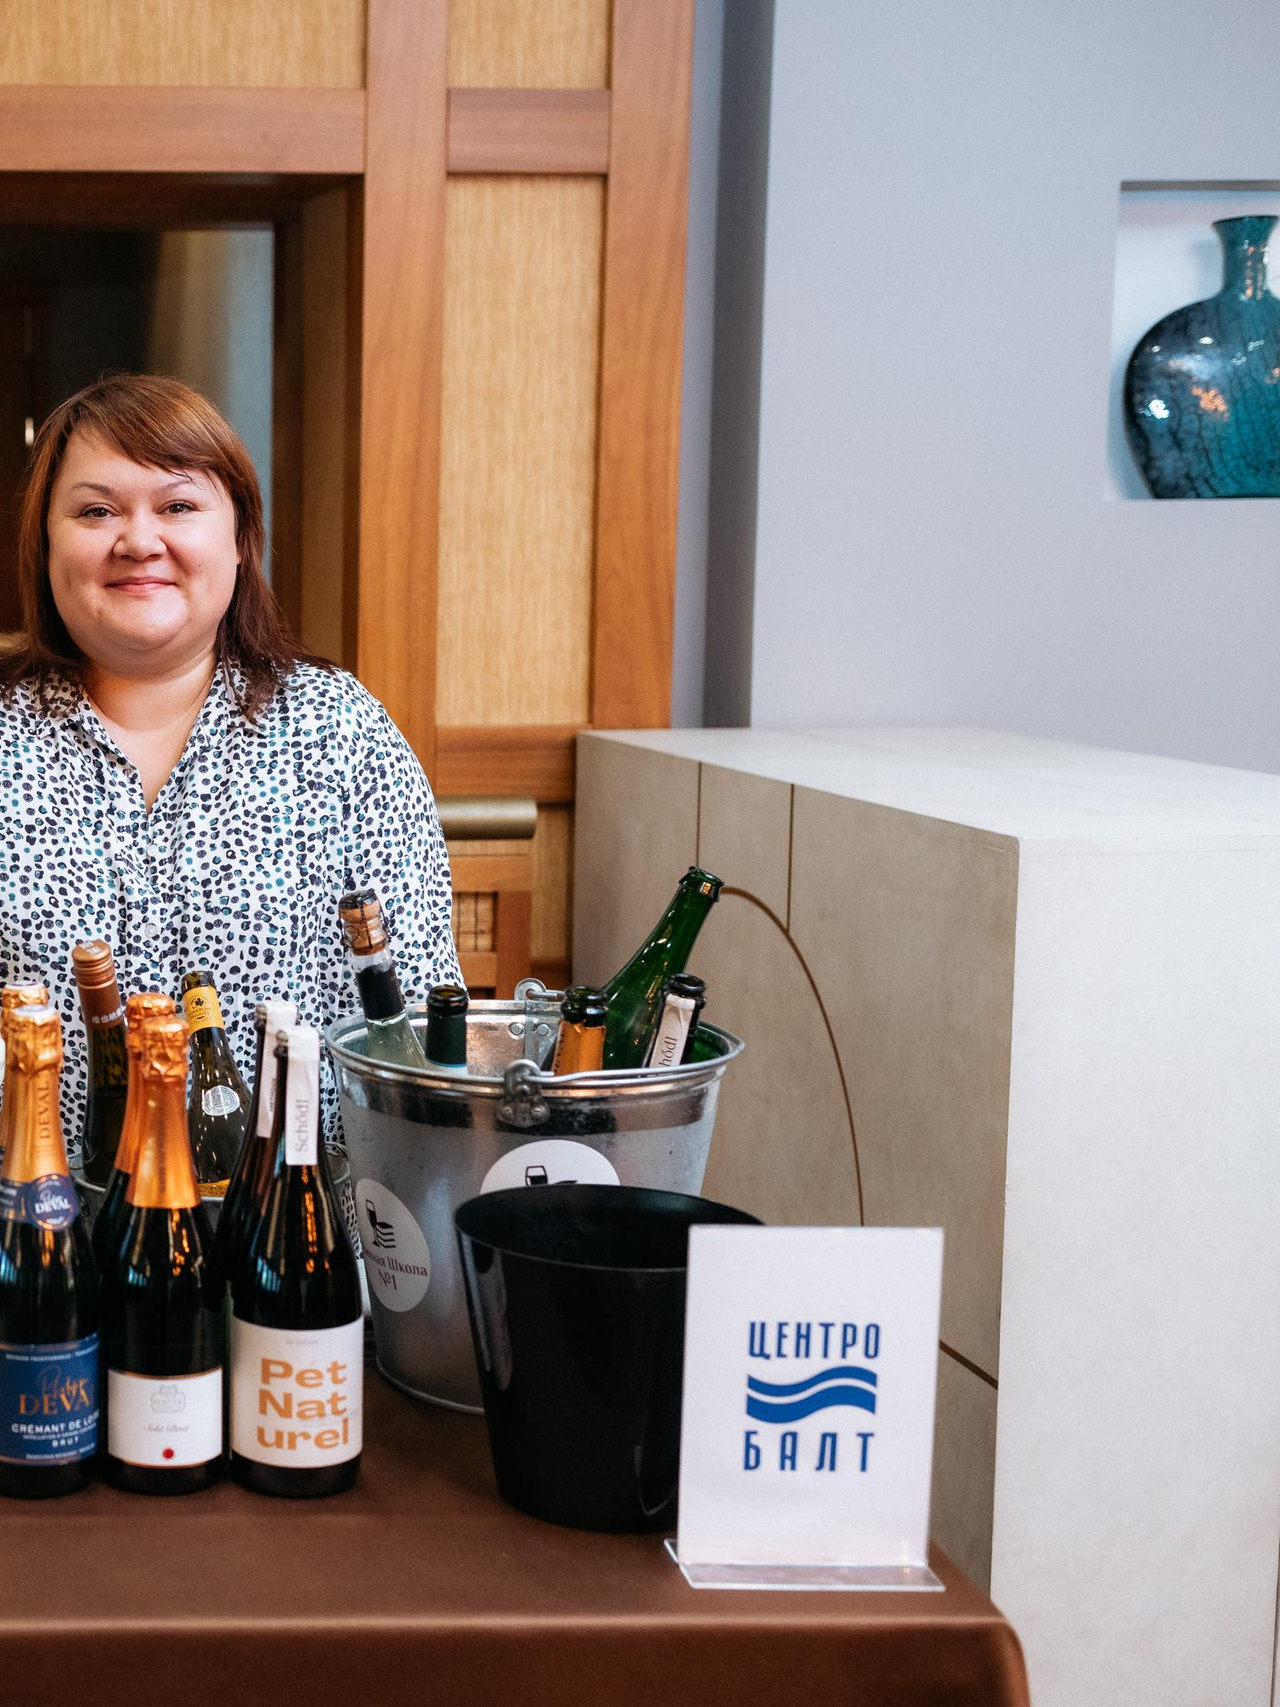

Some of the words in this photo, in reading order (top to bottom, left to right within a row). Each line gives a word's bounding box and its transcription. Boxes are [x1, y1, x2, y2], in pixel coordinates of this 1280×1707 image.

[37, 1080, 50, 1139] DEVAL
[377, 1268, 398, 1292] №1
[387, 1256, 428, 1277] Школа
[748, 1321, 882, 1360] ЦЕНТРО
[261, 1357, 347, 1389] Pet
[258, 1389, 348, 1420] Nat
[52, 1436, 79, 1448] BRUT
[256, 1417, 349, 1451] urel
[743, 1429, 875, 1473] БАЛТ
